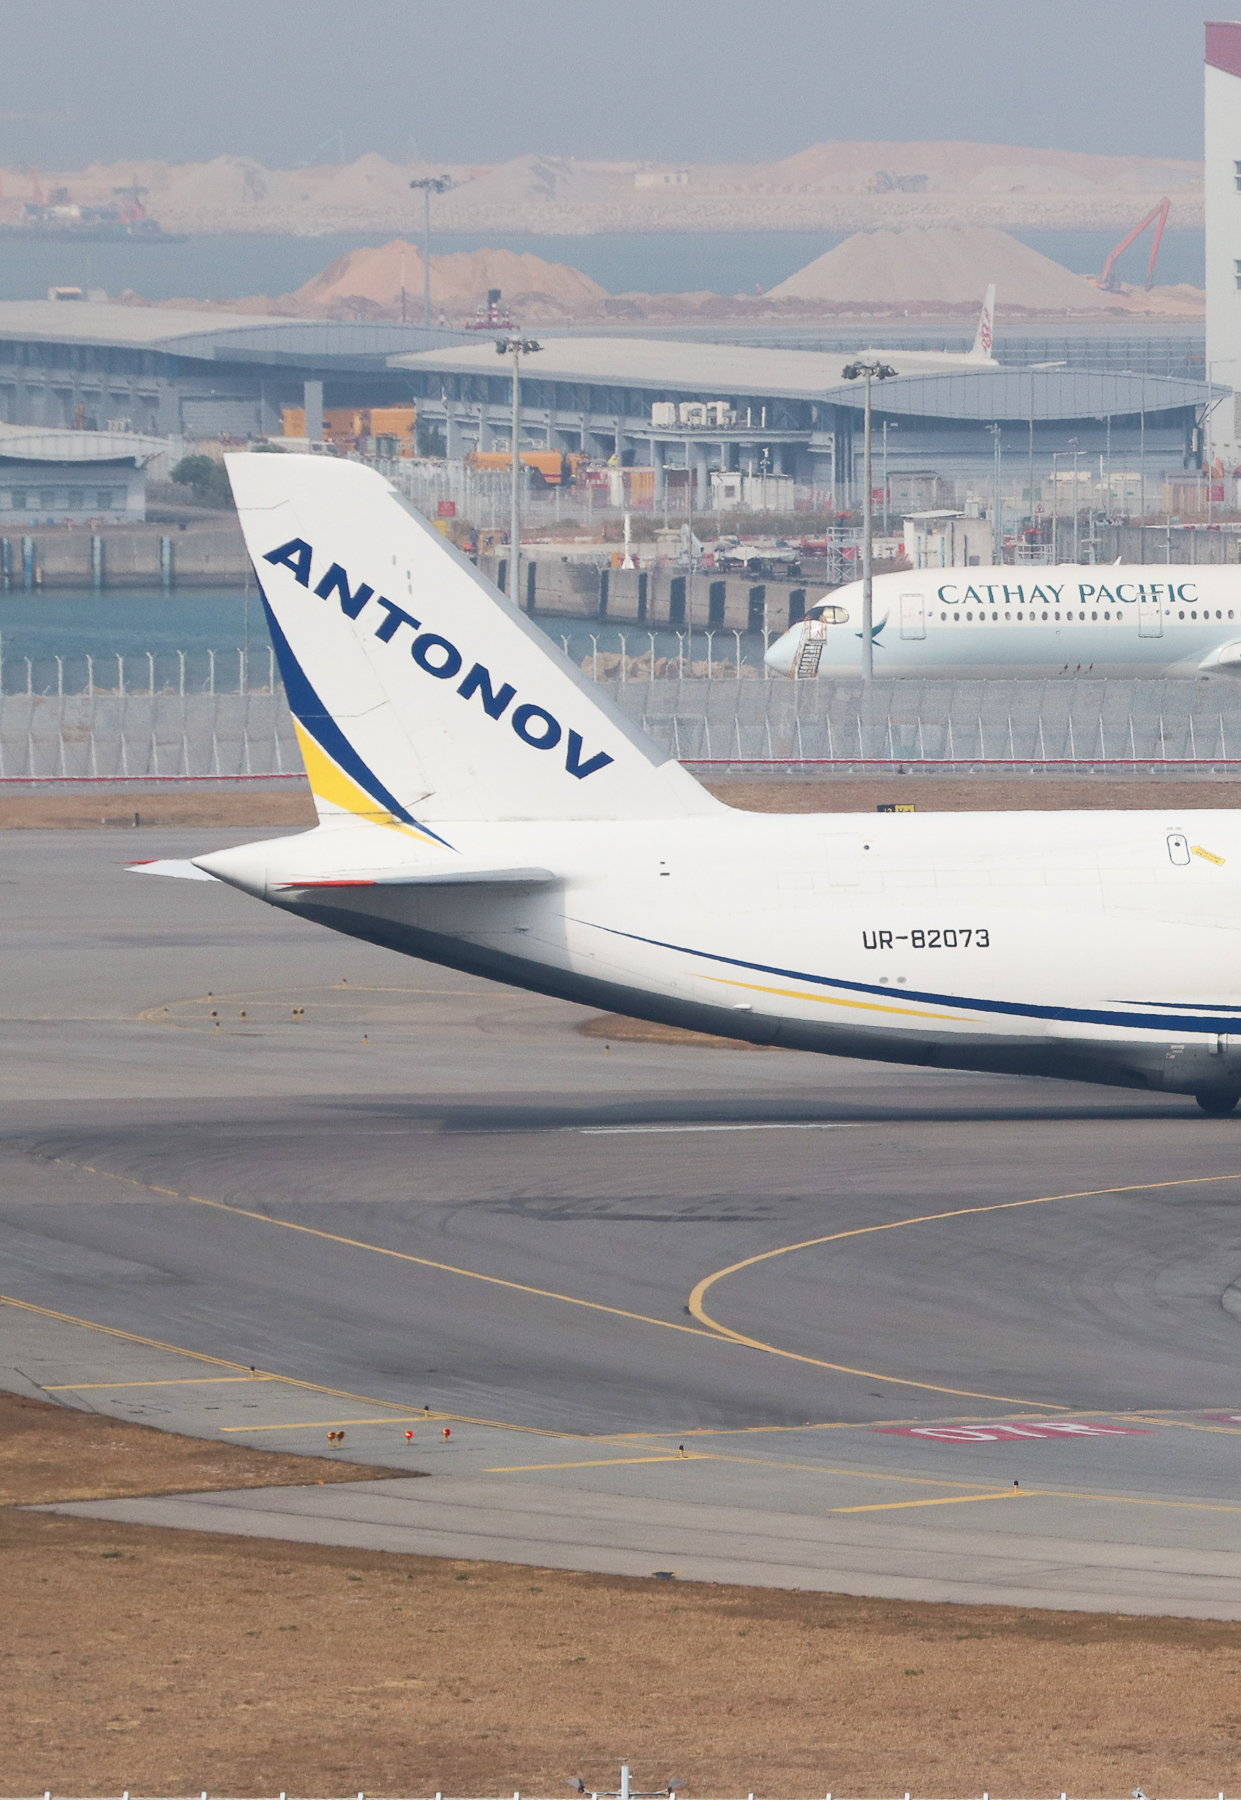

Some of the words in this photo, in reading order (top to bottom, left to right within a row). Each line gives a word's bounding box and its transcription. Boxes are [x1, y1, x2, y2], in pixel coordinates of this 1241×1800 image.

[937, 584, 1066, 605] CATHAY
[1078, 583, 1199, 604] PACIFIC
[261, 537, 615, 780] ANTONOV
[861, 928, 990, 950] UR-82073
[911, 1422, 1126, 1441] 07R
